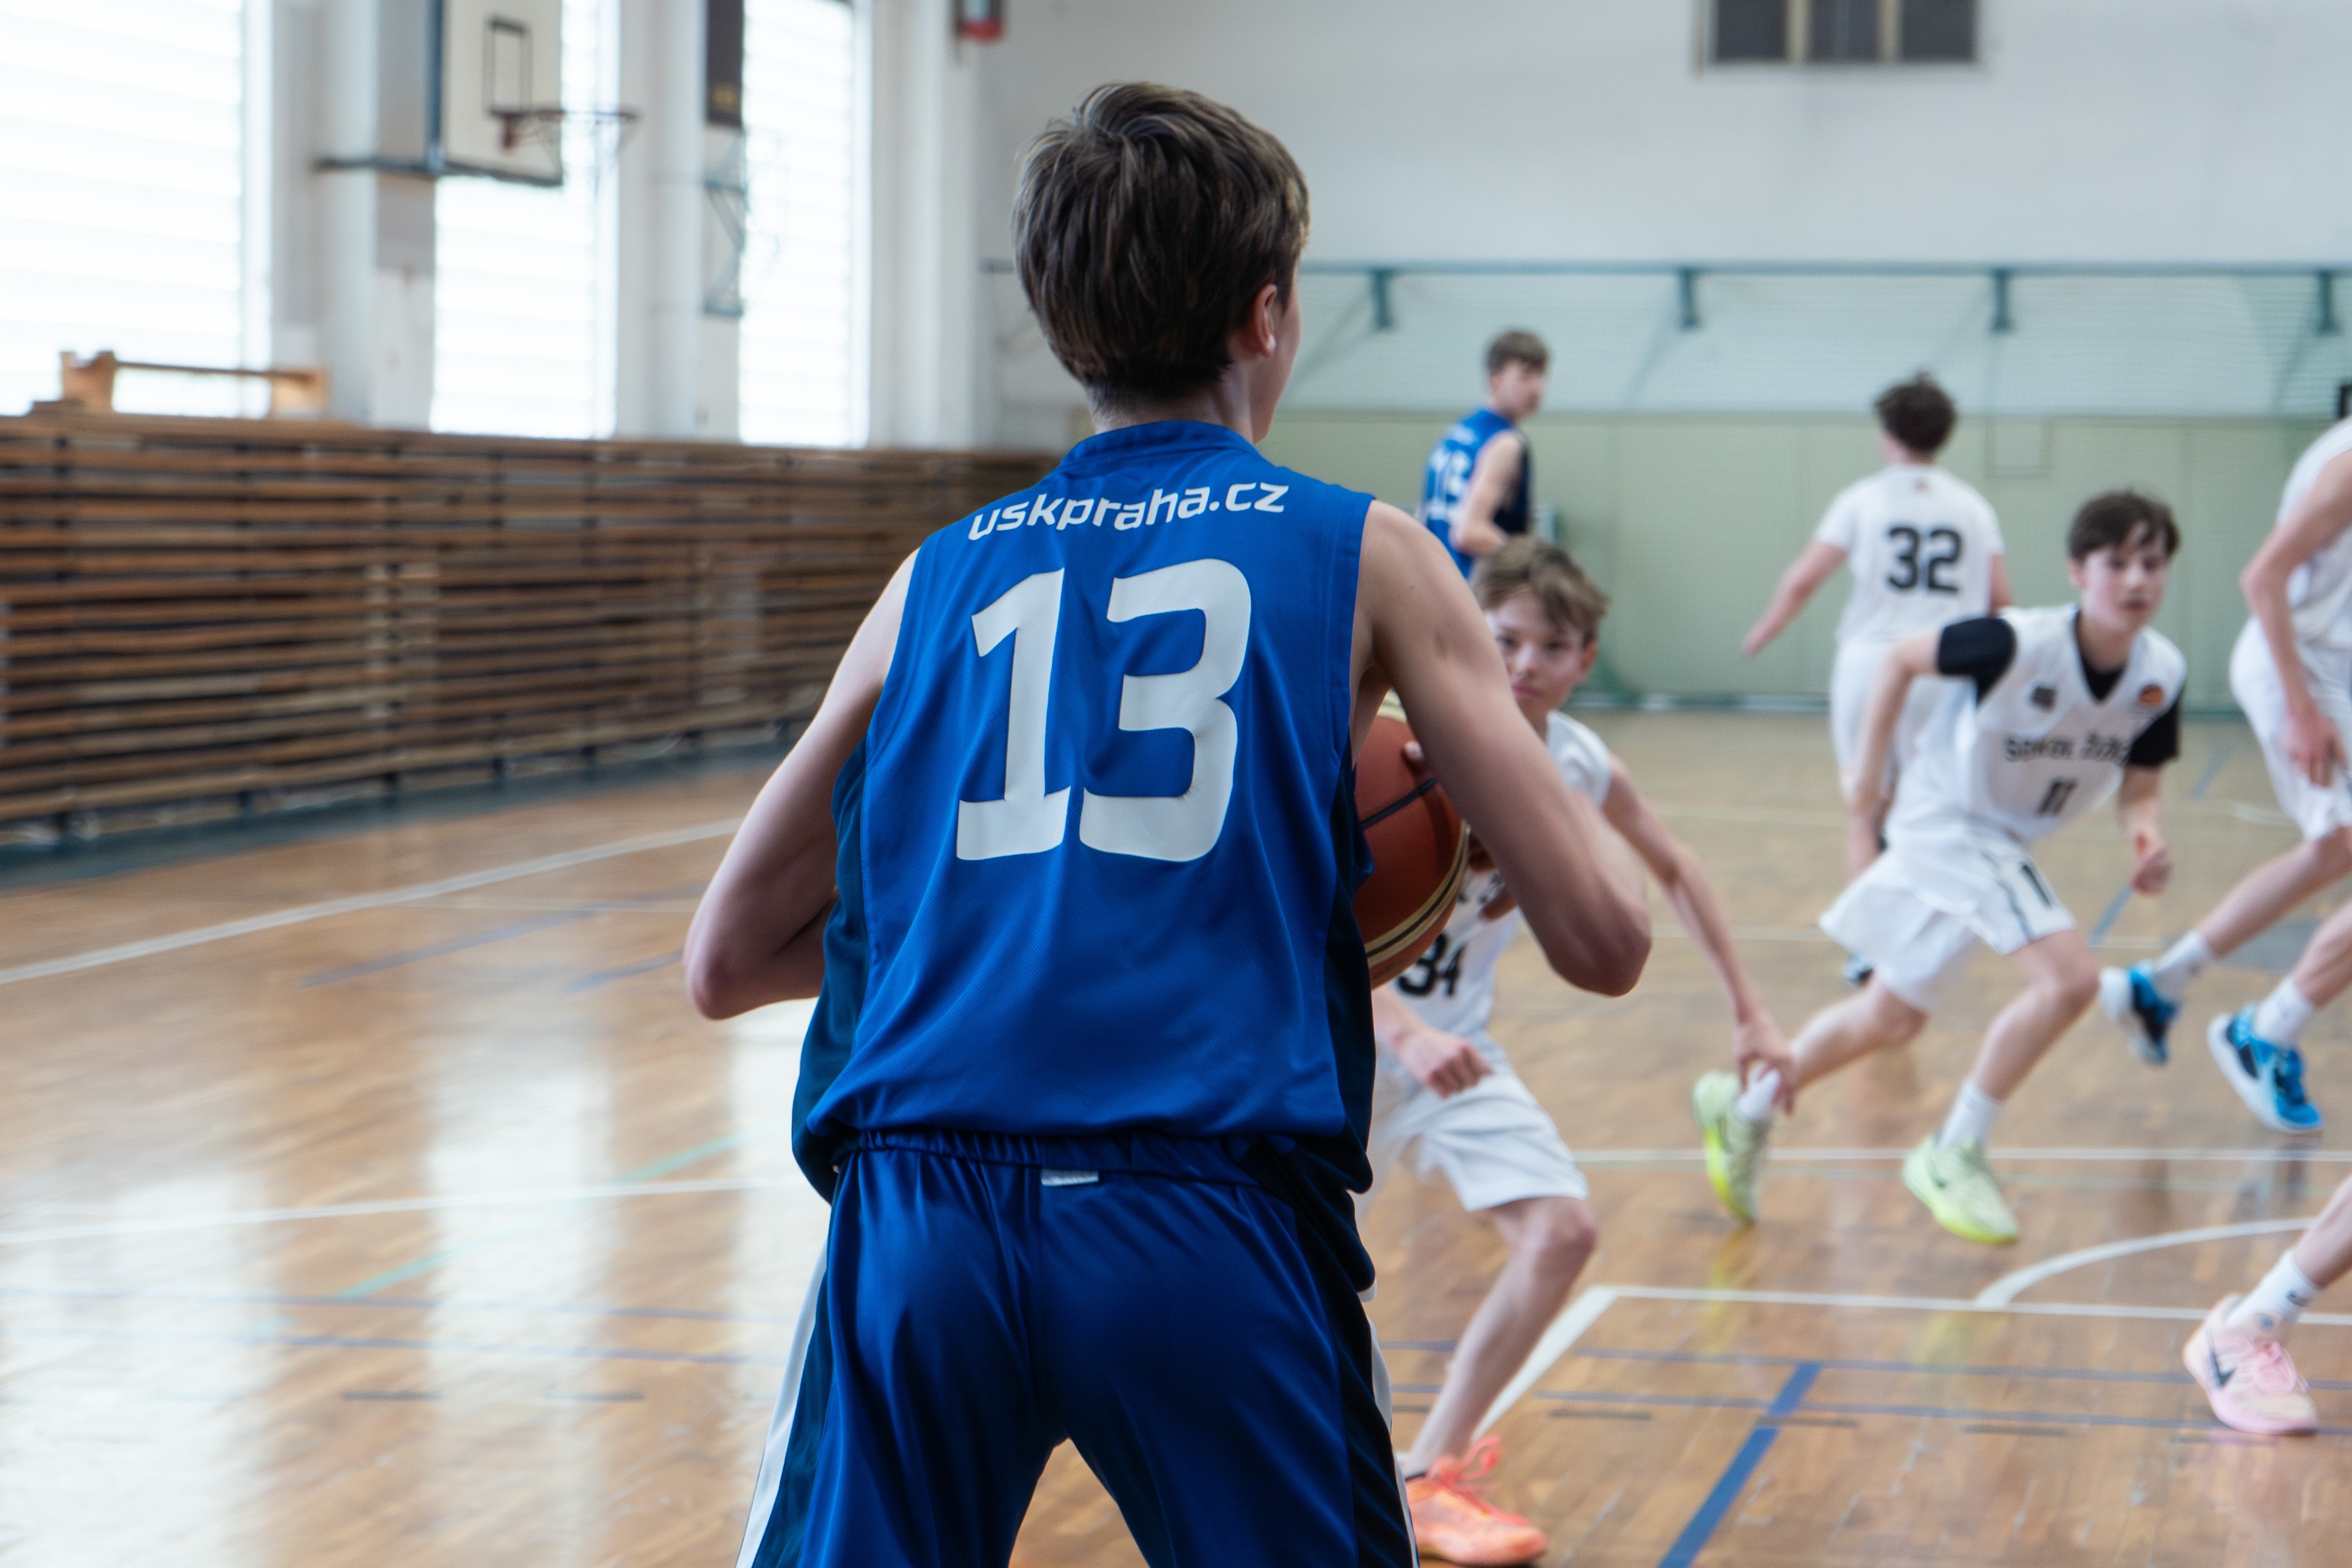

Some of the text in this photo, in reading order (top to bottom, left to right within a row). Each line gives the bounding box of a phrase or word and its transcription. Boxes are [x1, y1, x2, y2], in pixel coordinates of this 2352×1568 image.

[968, 482, 1289, 540] uskpraha.cz
[1886, 524, 1964, 595] 32
[956, 558, 1252, 862] 13
[1396, 932, 1468, 997] 34
